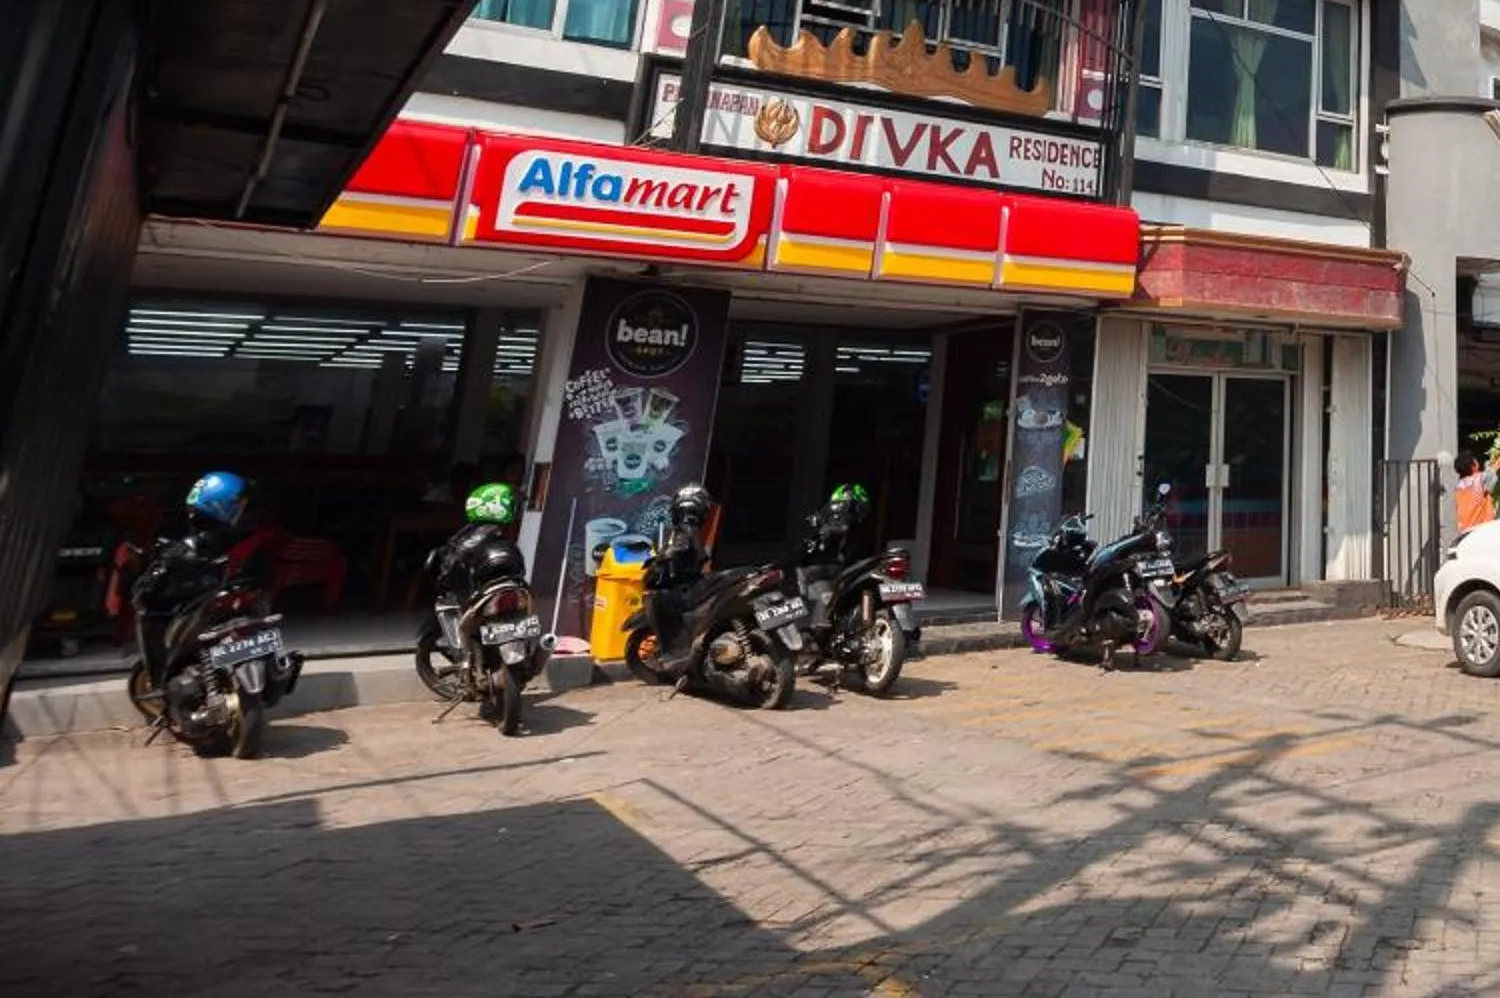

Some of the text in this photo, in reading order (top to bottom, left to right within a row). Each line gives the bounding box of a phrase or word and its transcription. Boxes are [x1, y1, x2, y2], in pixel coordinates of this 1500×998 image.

[807, 105, 1000, 179] DIVKA
[1009, 135, 1101, 169] RESIDENCE
[518, 157, 740, 214] Alfamart
[616, 318, 689, 347] bean!
